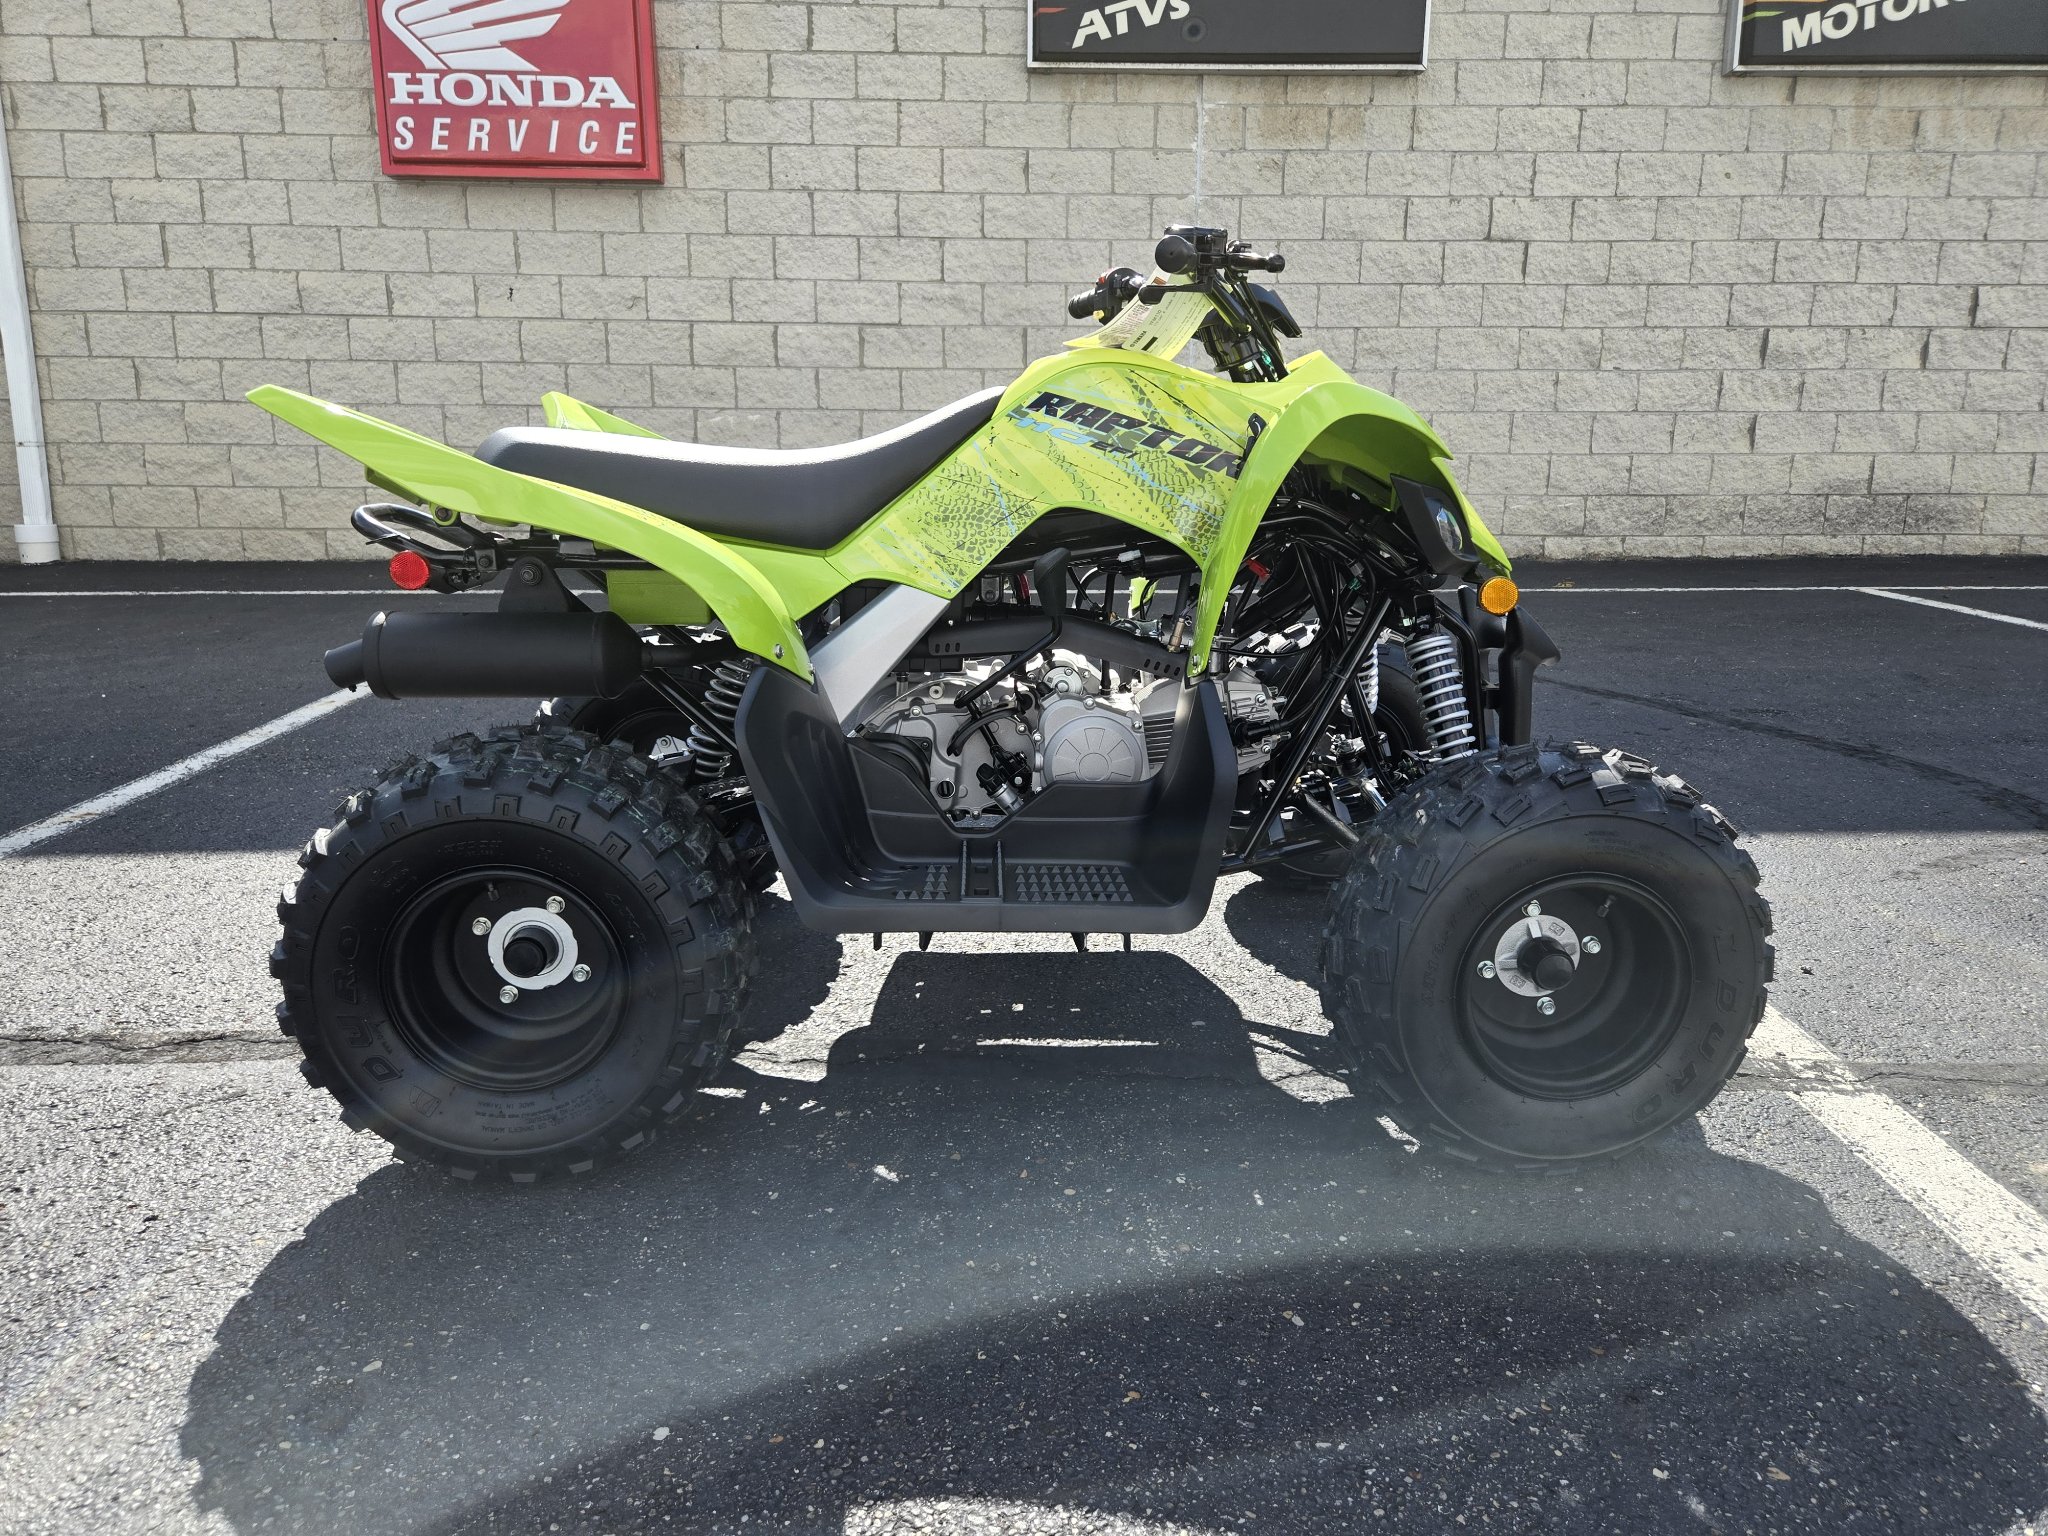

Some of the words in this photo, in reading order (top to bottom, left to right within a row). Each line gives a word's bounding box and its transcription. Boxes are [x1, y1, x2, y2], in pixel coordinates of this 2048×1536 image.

[1071, 0, 1191, 49] ATVs
[387, 72, 636, 109] HONDA
[393, 116, 637, 155] SERVICE
[1025, 391, 1242, 480] RAPTOR
[331, 925, 403, 1084] DURO
[1631, 977, 1738, 1124] DURO
